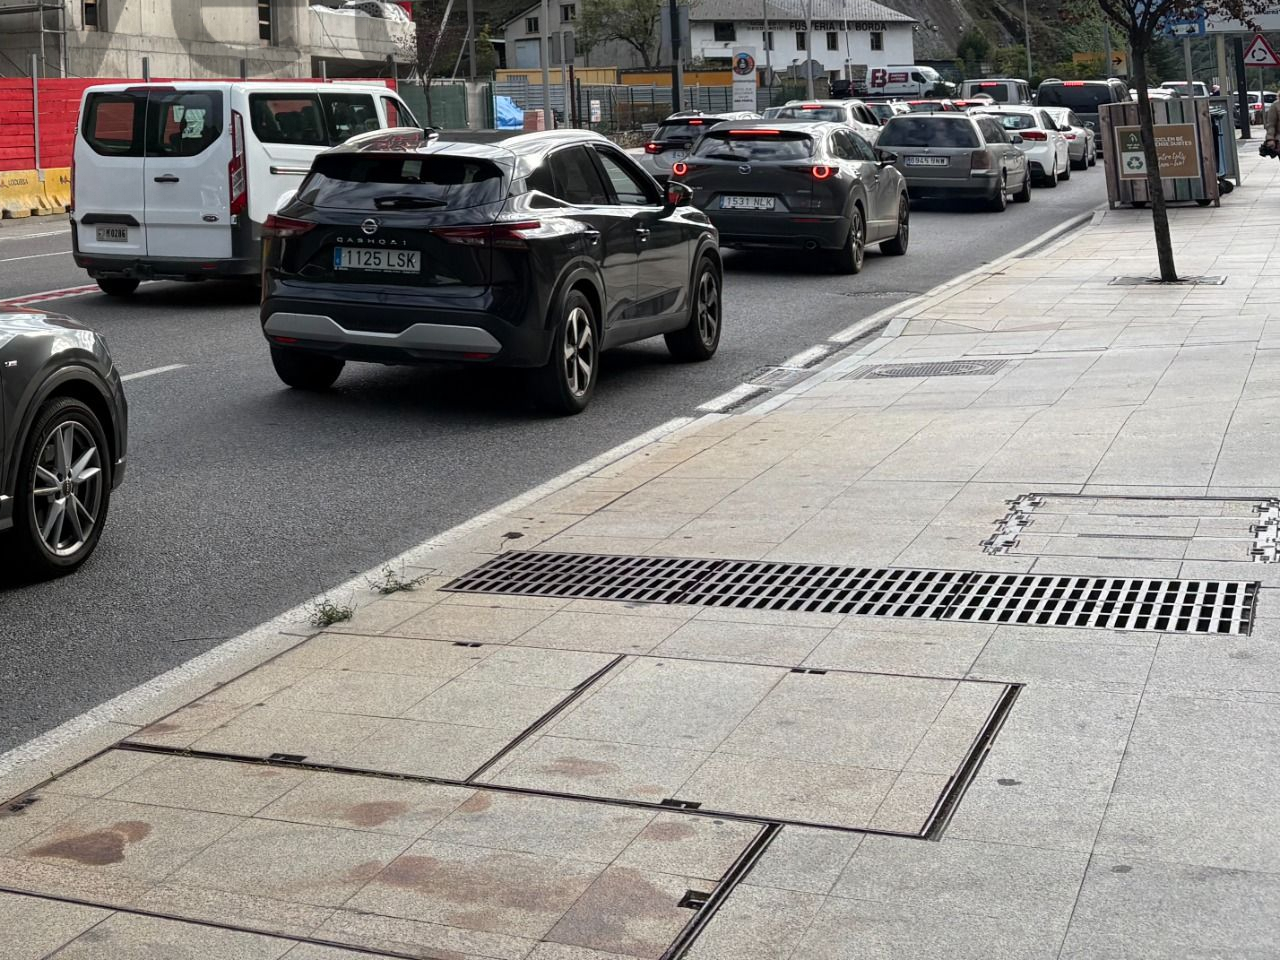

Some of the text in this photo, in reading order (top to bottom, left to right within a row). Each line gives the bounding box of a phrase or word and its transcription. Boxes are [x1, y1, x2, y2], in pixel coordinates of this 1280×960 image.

[789, 22, 835, 31] FUSERIA
[855, 22, 887, 31] BORDA
[727, 197, 775, 206] 1531 NLK
[347, 250, 416, 268] 1125 LSK
